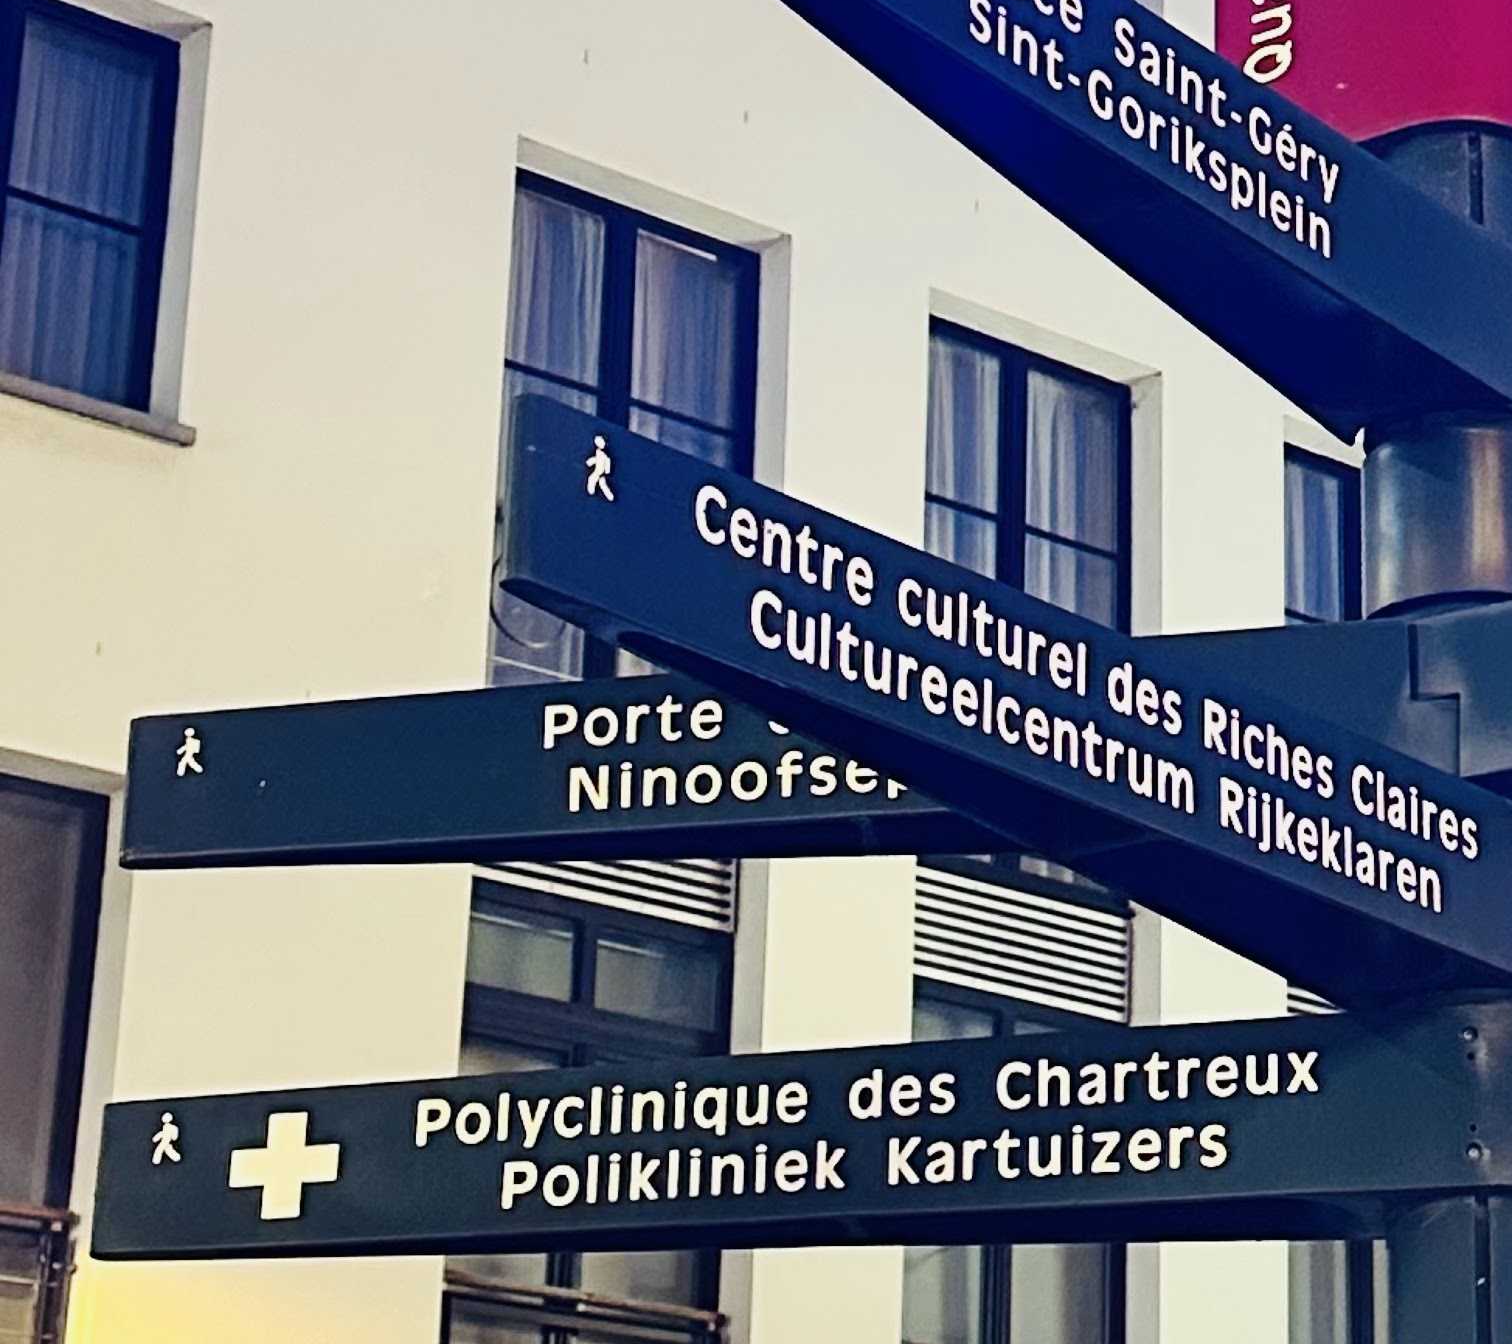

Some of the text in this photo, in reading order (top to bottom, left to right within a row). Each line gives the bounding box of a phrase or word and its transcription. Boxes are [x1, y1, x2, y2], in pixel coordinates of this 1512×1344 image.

[1113, 17, 1340, 204] Saint-Géry
[543, 695, 724, 749] Porte
[694, 484, 1481, 860] Centre culturel des Riches Claires
[749, 589, 1445, 915] Cultureelcentrum Rijkeklaren
[414, 1051, 1319, 1150] Polyclinique des Chartreux
[499, 1124, 1229, 1212] Polikliniek Kartuizers
